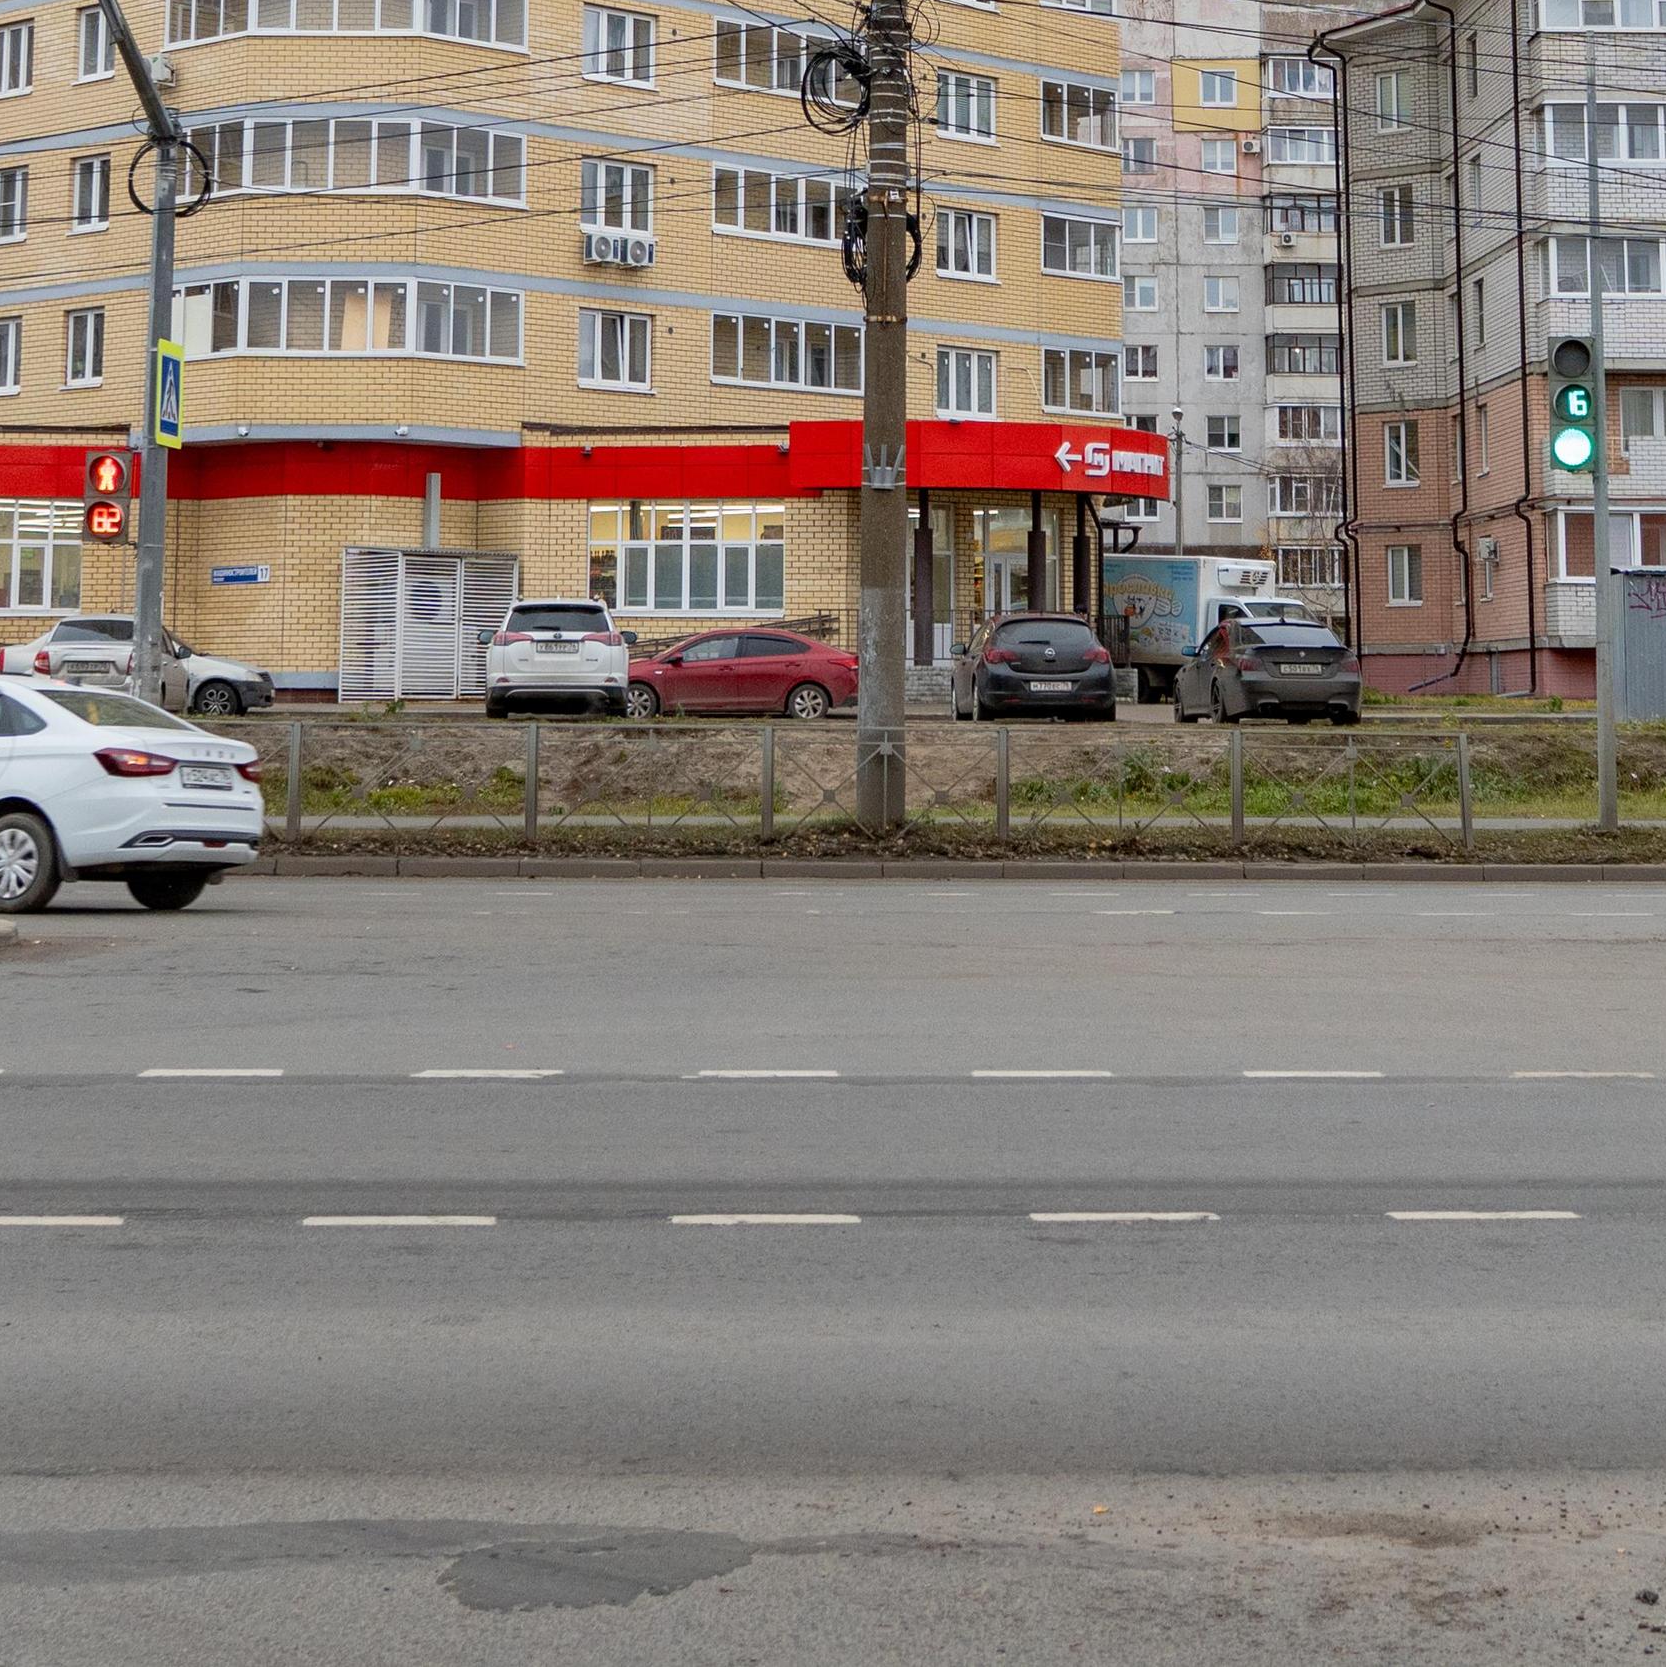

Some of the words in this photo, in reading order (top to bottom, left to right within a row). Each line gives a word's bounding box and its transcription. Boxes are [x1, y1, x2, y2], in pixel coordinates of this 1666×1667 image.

[1568, 390, 1588, 416] 16
[1112, 450, 1165, 476] МАГНИТ
[92, 507, 121, 533] 82
[259, 568, 269, 580] 17
